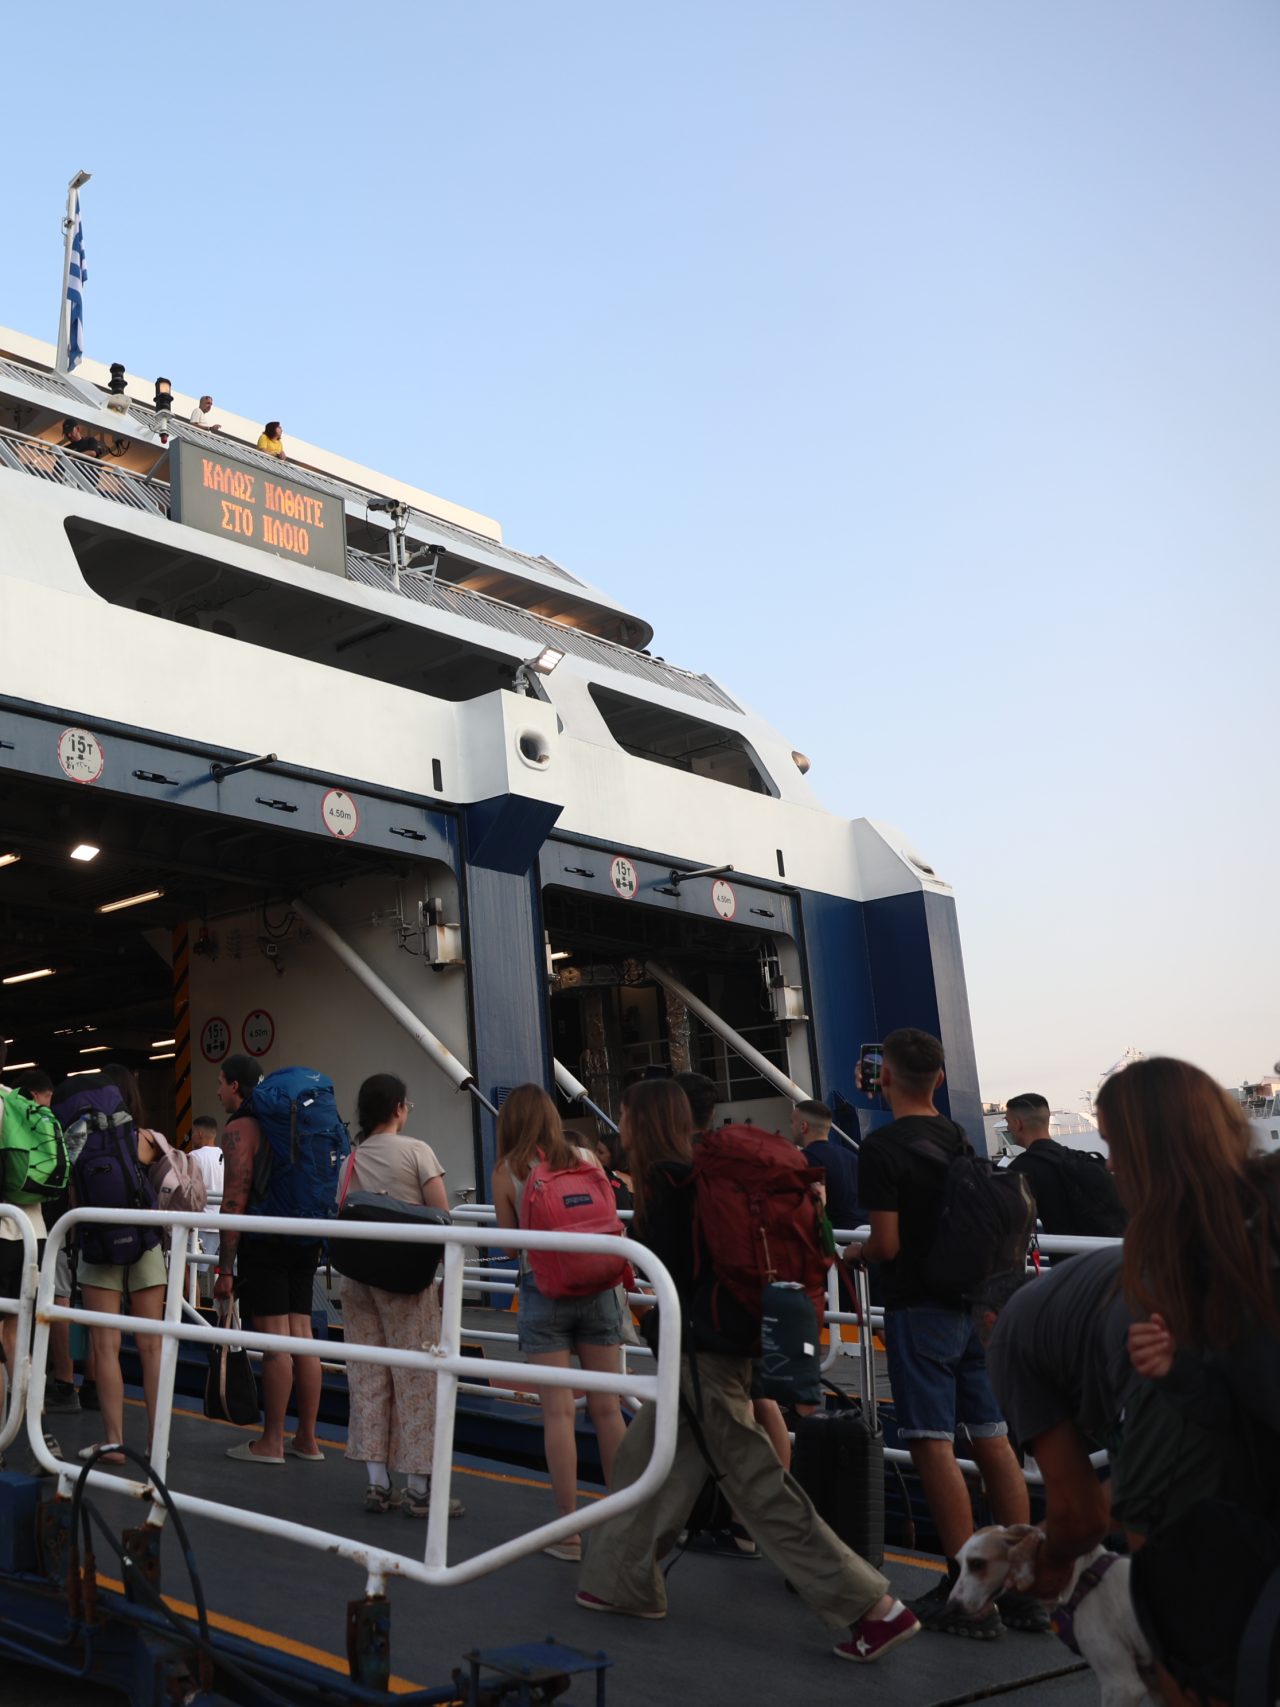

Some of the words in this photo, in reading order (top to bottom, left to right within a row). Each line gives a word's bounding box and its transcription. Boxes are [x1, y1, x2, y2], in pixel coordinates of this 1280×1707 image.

[202, 459, 255, 504] ΚΑΛΩΣ
[264, 481, 324, 528] ΗΛΘΑΤΕ
[221, 500, 254, 537] ΣΤΟ
[262, 514, 309, 556] ΠΛΟΙΟ
[329, 808, 352, 821] 4.50m
